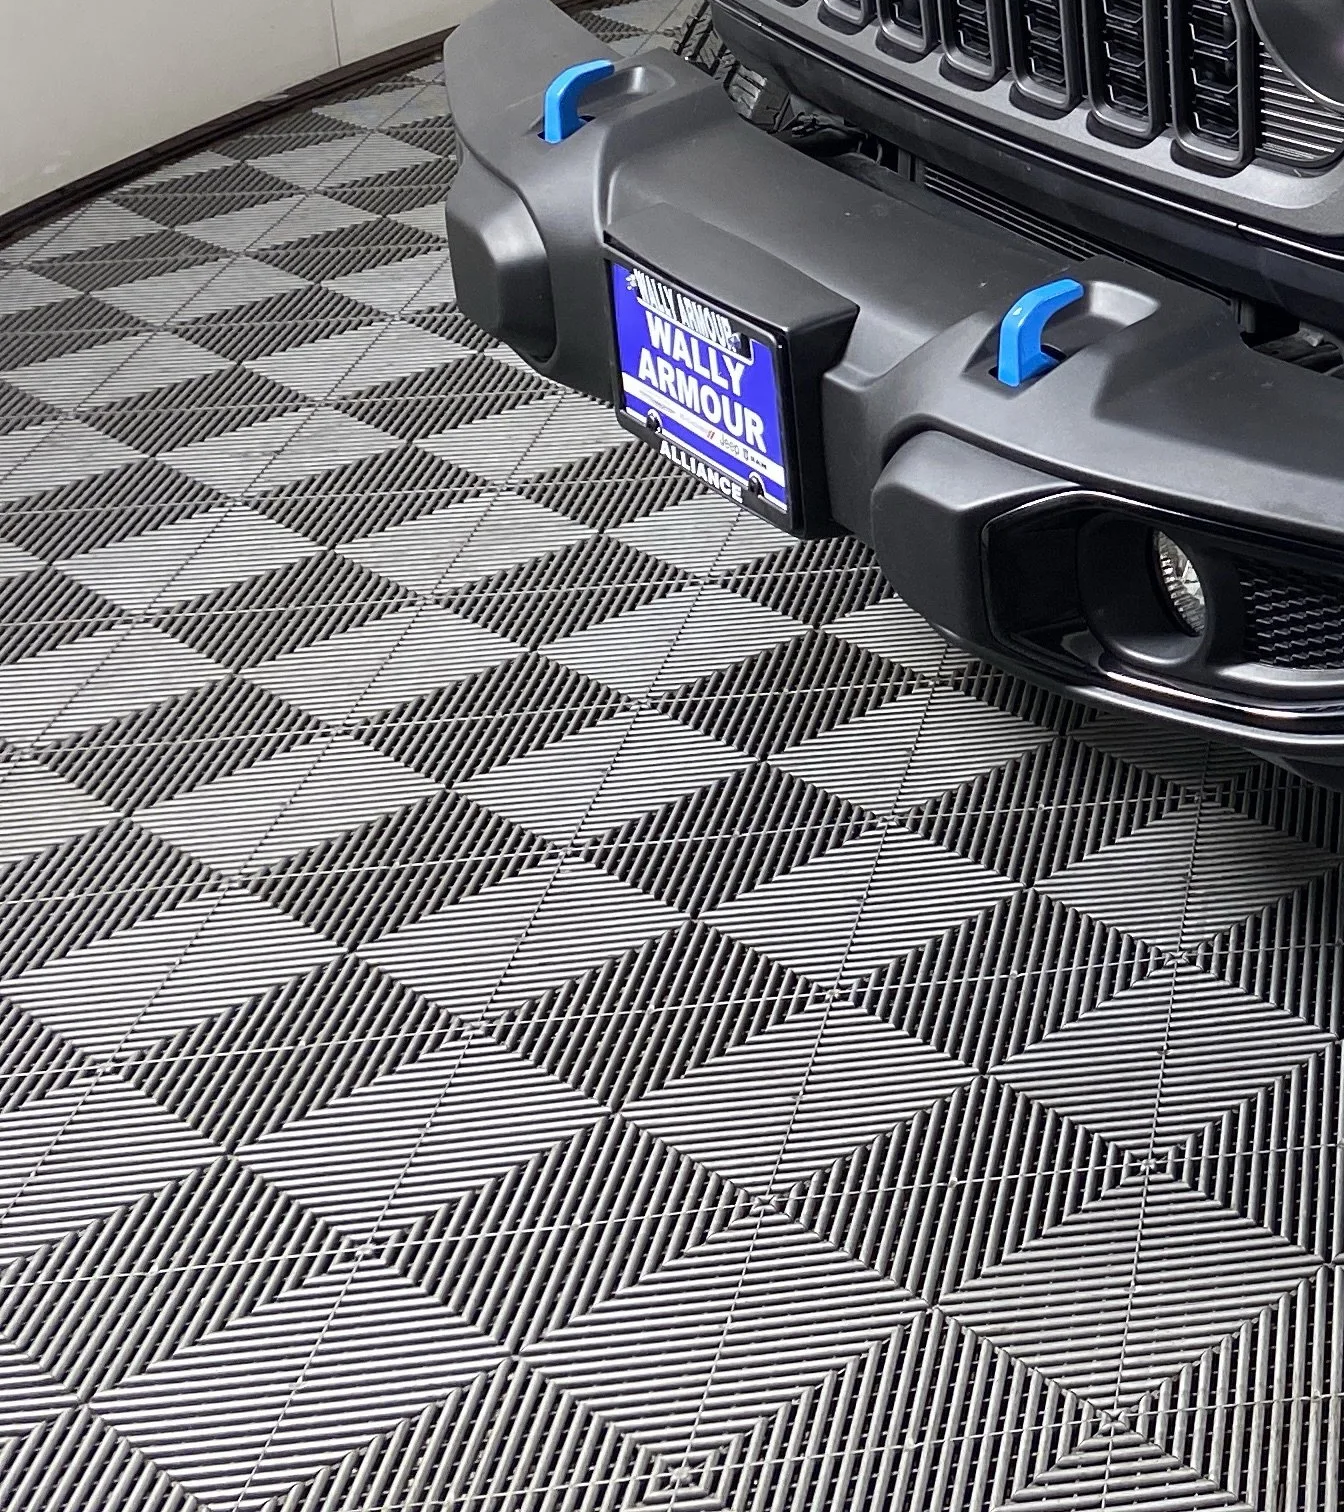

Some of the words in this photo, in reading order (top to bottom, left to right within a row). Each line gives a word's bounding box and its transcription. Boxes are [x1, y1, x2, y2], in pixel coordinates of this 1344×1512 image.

[633, 268, 678, 320] WALLY
[645, 310, 746, 397] WALLY
[638, 347, 768, 454] ARMOUR
[660, 440, 743, 504] ALLIANCE
